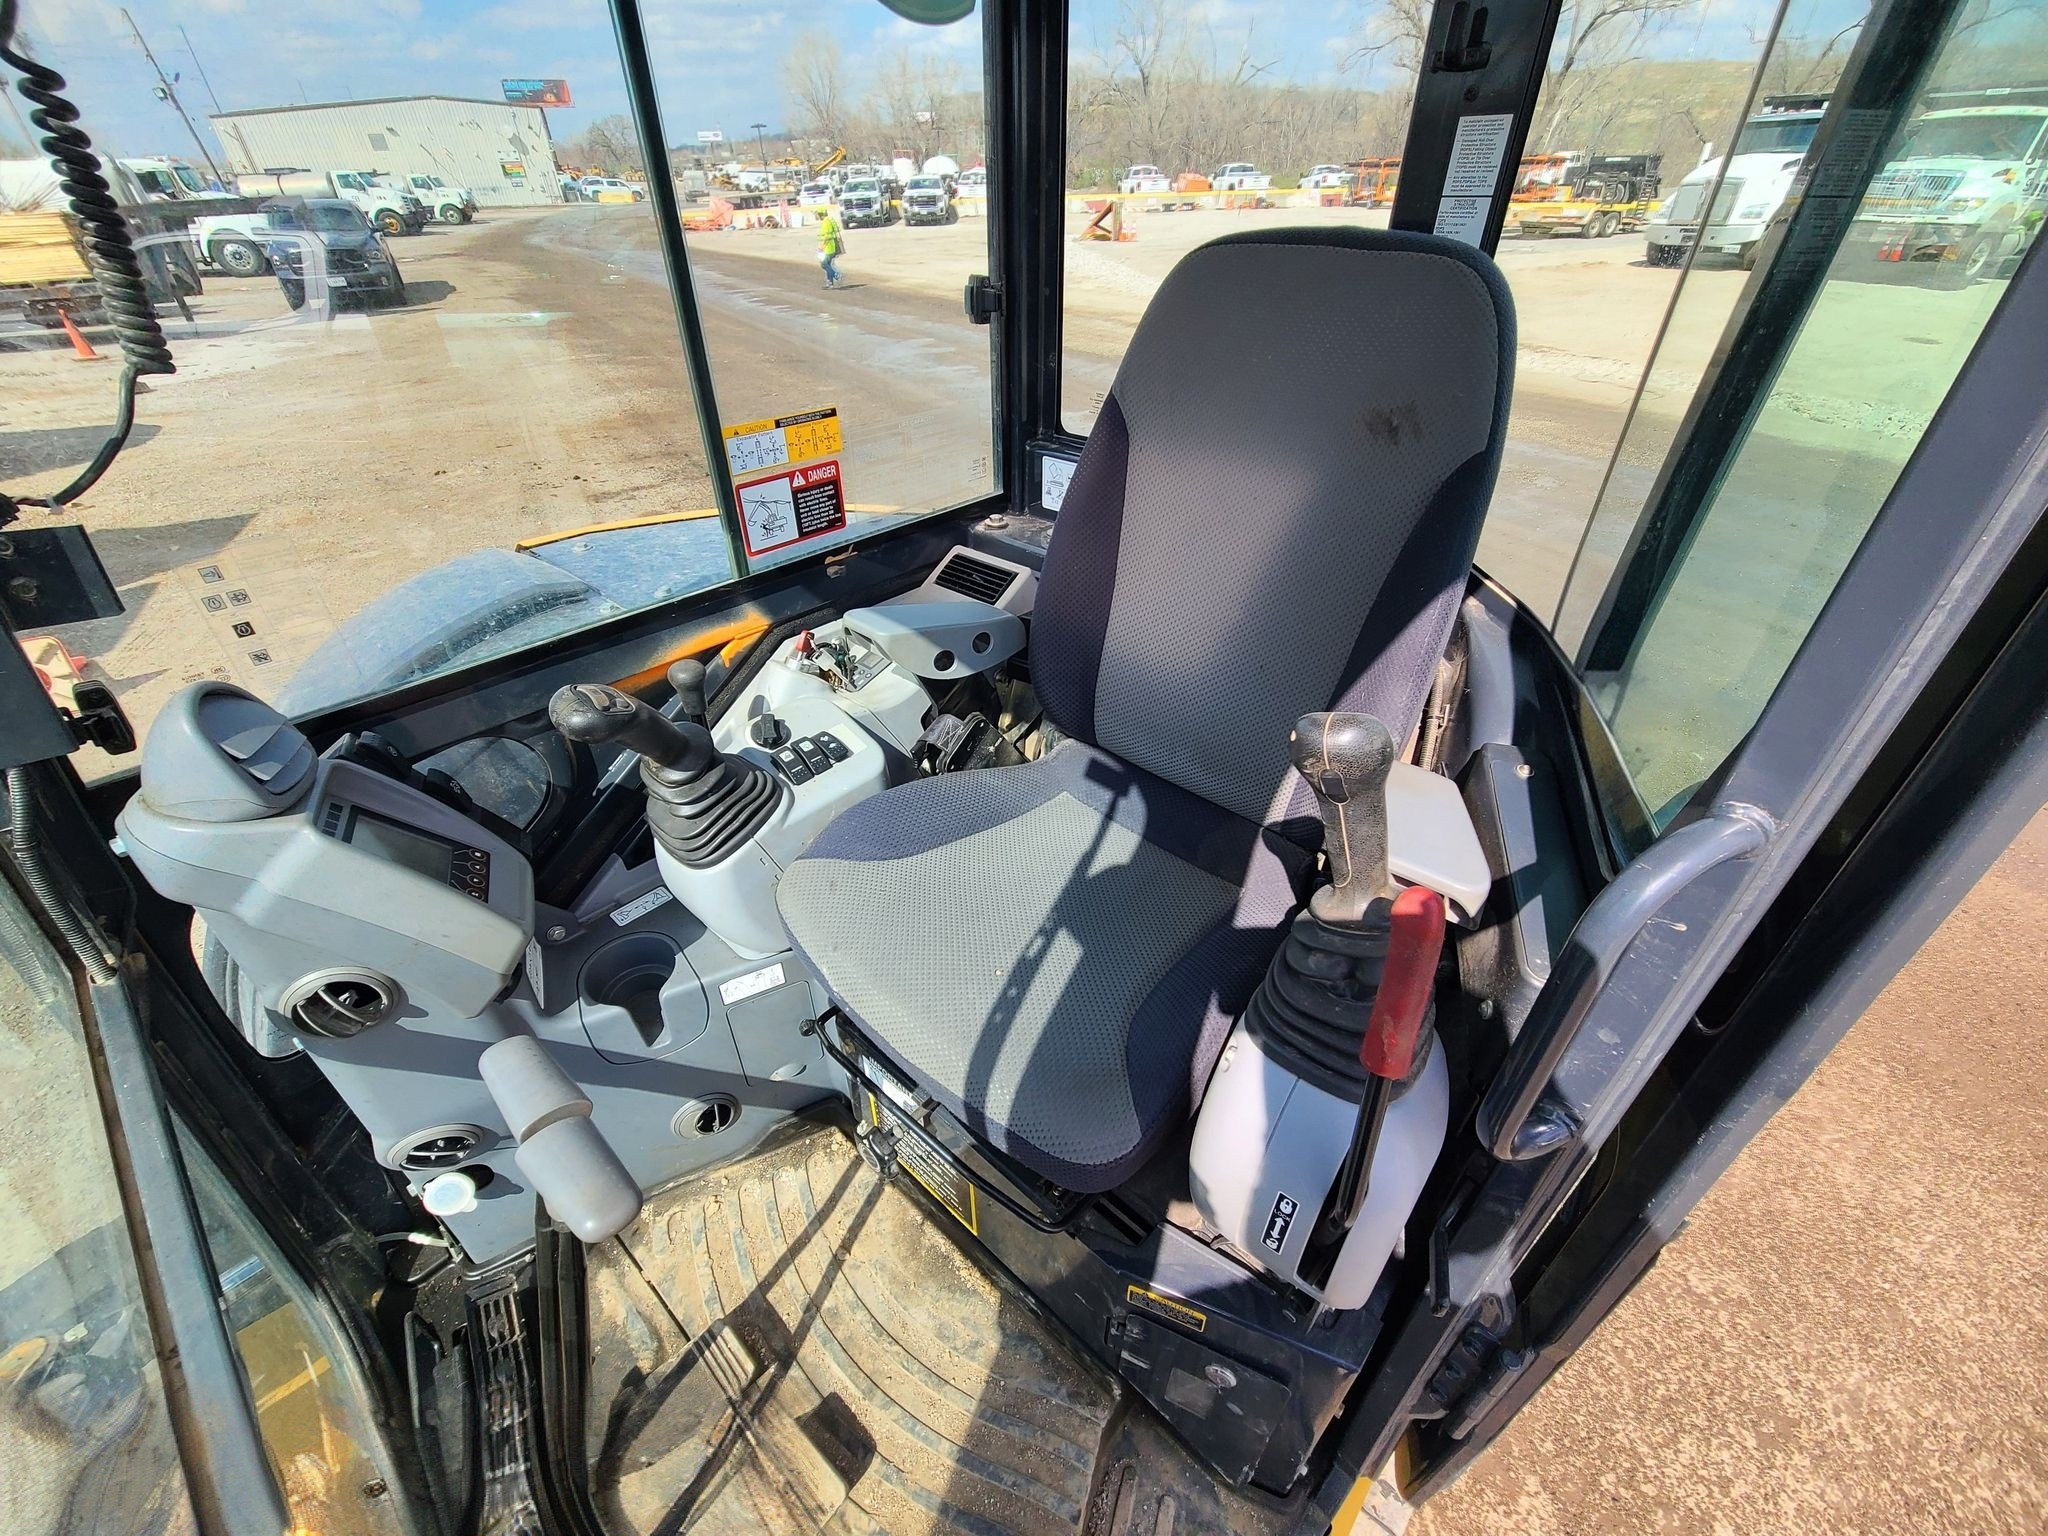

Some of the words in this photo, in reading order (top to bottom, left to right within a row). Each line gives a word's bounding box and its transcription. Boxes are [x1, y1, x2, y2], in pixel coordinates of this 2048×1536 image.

[744, 423, 768, 433] CAUTION
[808, 465, 836, 482] DANGER
[868, 1056, 912, 1097] IMPORTANT
[1274, 1209, 1290, 1222] LOCK
